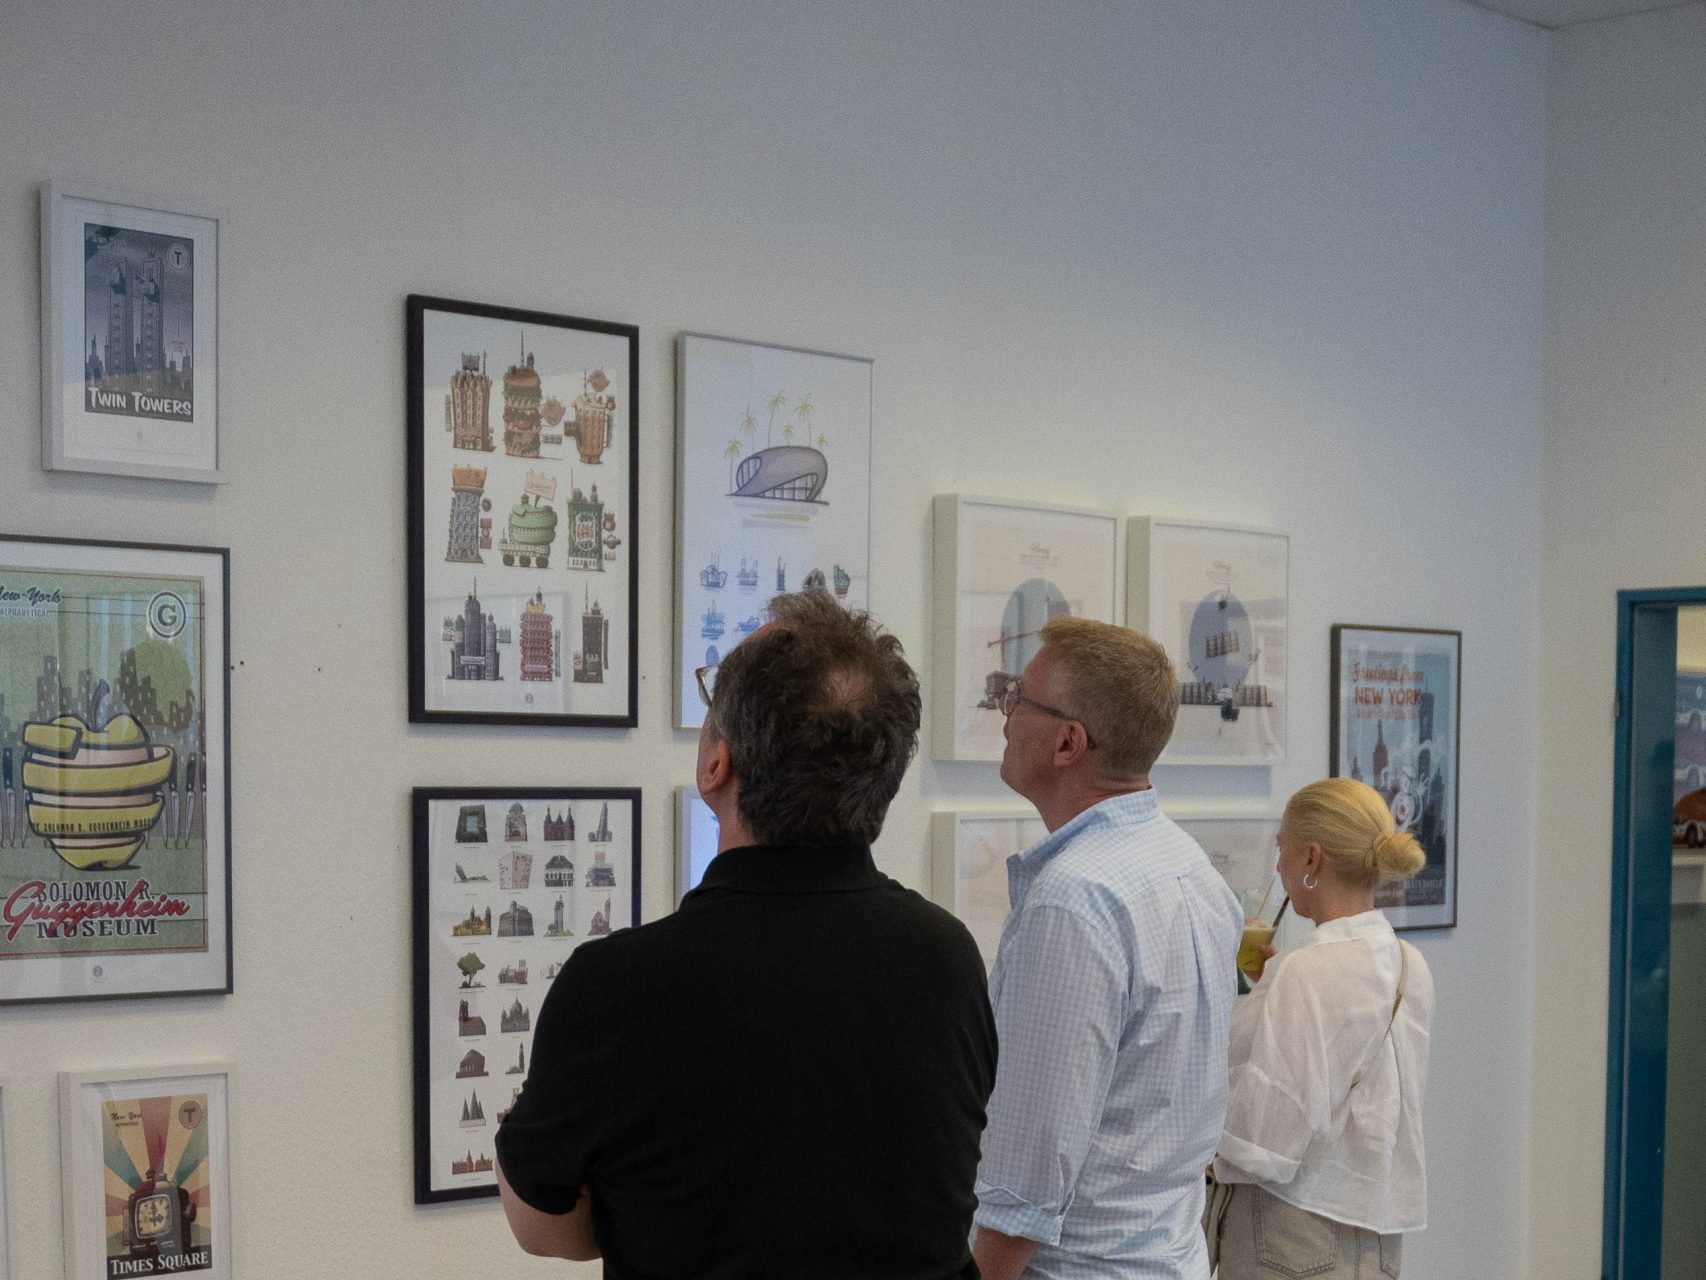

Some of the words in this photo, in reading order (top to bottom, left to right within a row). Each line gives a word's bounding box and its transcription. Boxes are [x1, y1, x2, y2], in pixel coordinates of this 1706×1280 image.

[88, 386, 126, 410] TWIN
[131, 391, 192, 416] TOWERS
[157, 604, 177, 627] G
[1354, 687, 1384, 705] NEW
[1388, 687, 1422, 706] YORK
[38, 880, 128, 902] SOLOMON
[138, 881, 156, 900] R.
[3, 878, 190, 941] Guggenheim
[37, 918, 158, 939] MUSEUM
[183, 1107, 196, 1123] T
[110, 1257, 154, 1276] TIMES
[157, 1251, 209, 1270] SQUARE
